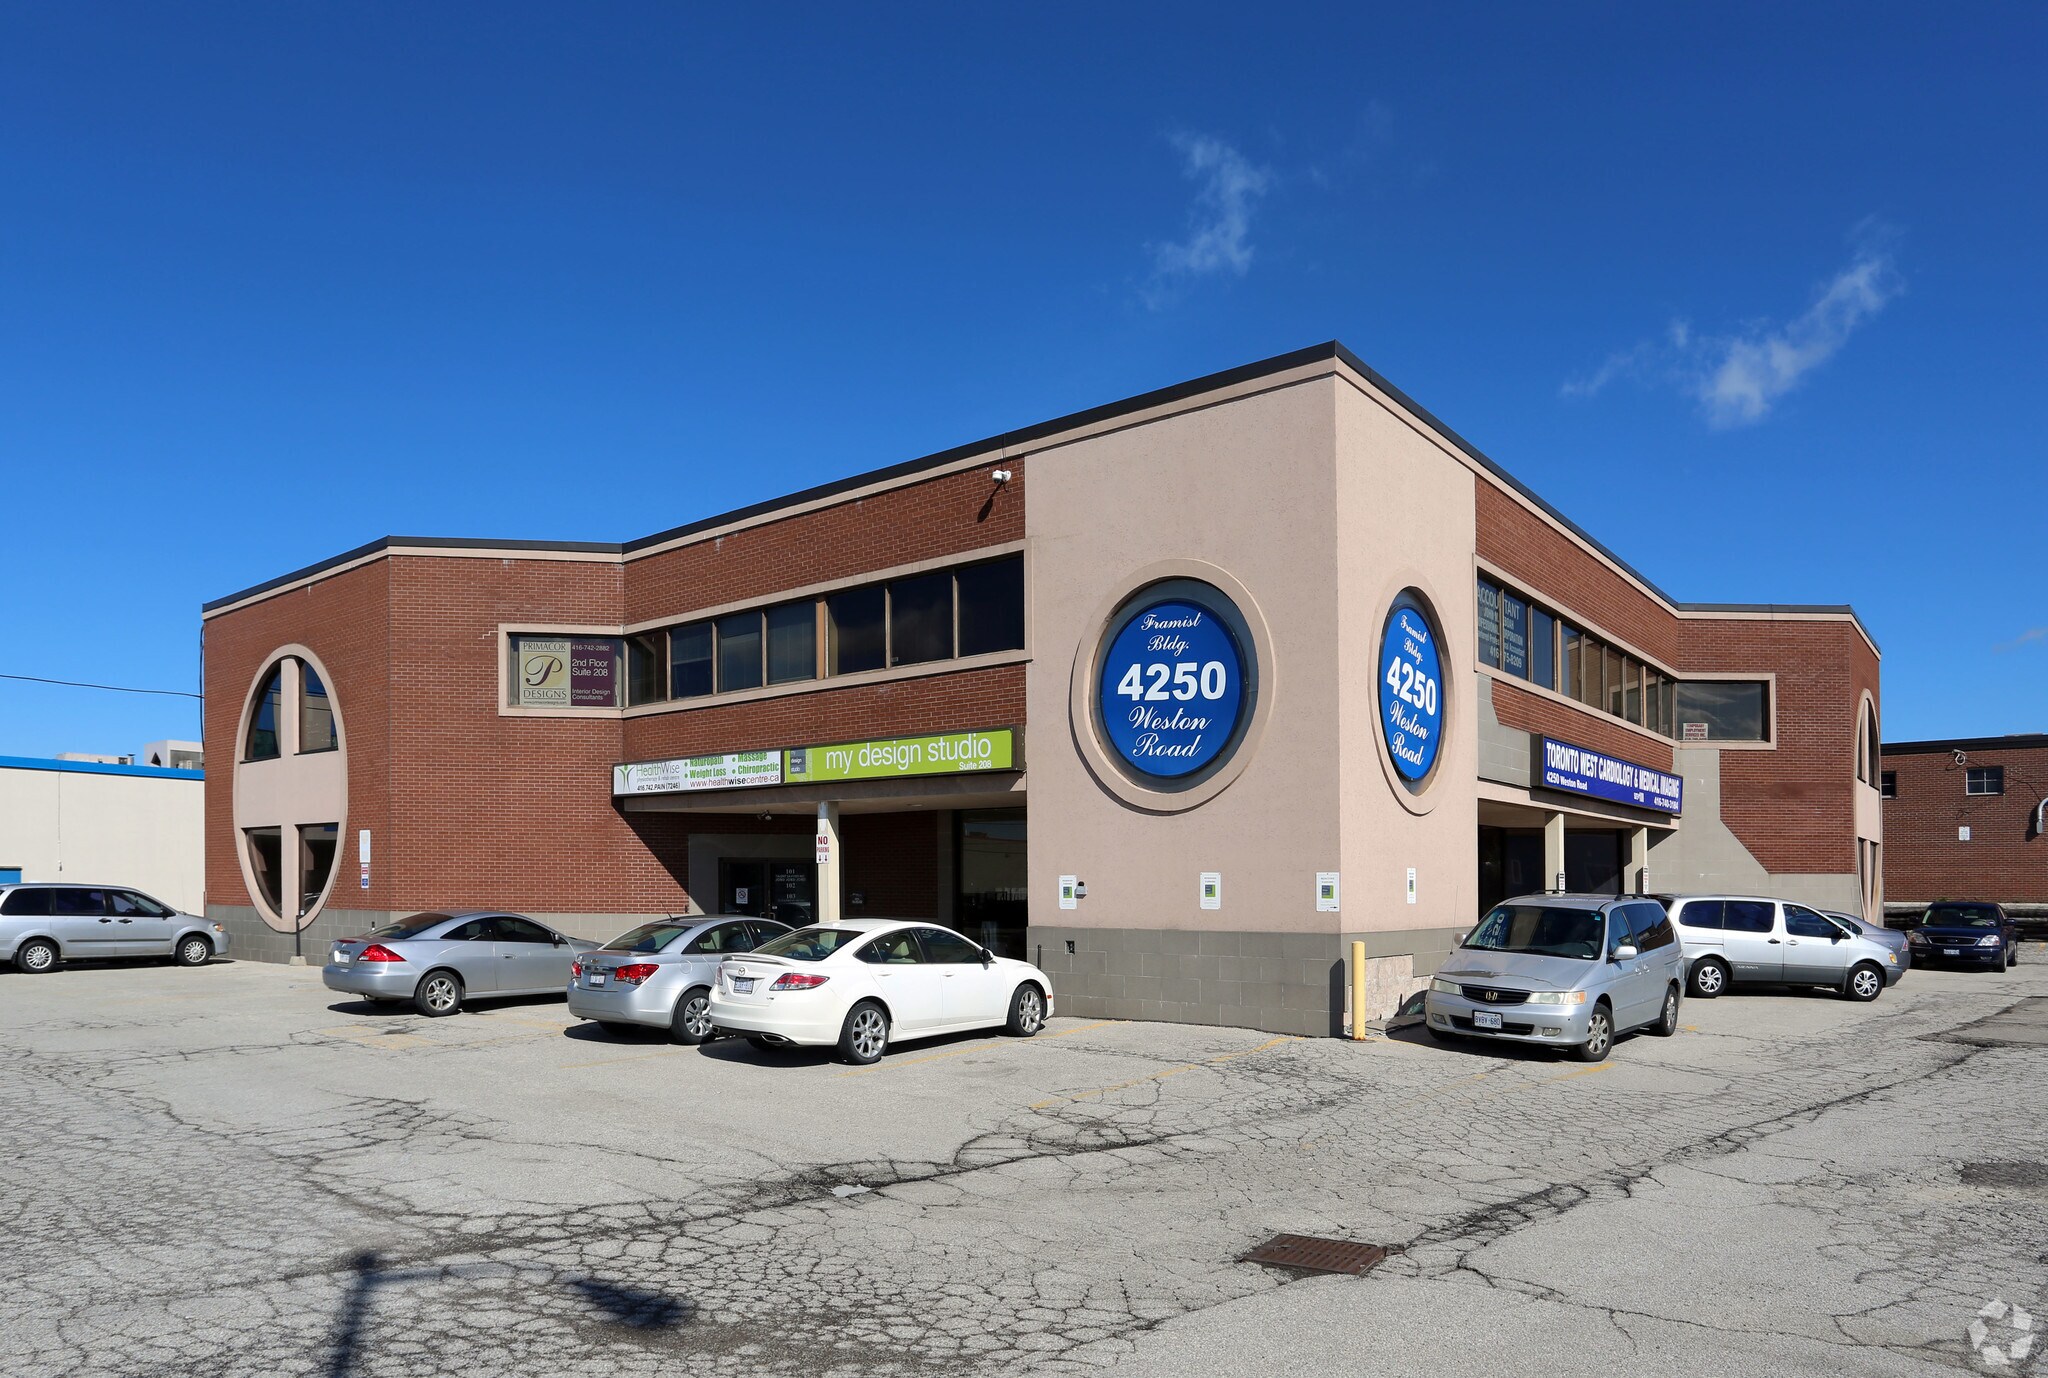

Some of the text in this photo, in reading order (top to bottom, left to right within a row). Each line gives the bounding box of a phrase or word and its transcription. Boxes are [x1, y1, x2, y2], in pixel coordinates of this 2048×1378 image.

[1141, 612, 1202, 631] Framist
[1401, 614, 1428, 645] Framist
[523, 642, 566, 651] PRIMACOR
[1147, 635, 1189, 657] Bldg.
[1403, 638, 1424, 666] Bldg.
[572, 659, 609, 667] 2nd Floor
[572, 668, 608, 677] Suite 208
[1117, 660, 1227, 702] 4250
[1386, 655, 1437, 717] 4250
[523, 690, 567, 699] DESIGNS
[592, 689, 611, 697] Design
[1128, 705, 1212, 730] Weston
[1389, 700, 1429, 740] Weston
[1133, 733, 1202, 757] Road
[1392, 731, 1425, 766] Road
[690, 756, 724, 767] Naturopath
[738, 752, 768, 762] Massage
[826, 749, 853, 775] my
[858, 740, 921, 771] design
[928, 734, 992, 762] studio
[637, 763, 680, 776] HealthWise
[690, 767, 727, 779] Weight Loss
[738, 762, 780, 775] Chiropractic
[958, 760, 992, 771] Suite 208
[1546, 742, 1579, 774] TORONTO
[1580, 752, 1598, 778] WEST
[1598, 757, 1634, 787] CARDIOLOGY
[1634, 768, 1638, 788] &
[1639, 769, 1660, 794] MEDICAL
[1660, 775, 1679, 799] IMAGING
[690, 774, 779, 788] www.healthwisecentre.ca
[1546, 771, 1588, 791] 4250 Weston Road
[818, 836, 828, 845] NO
